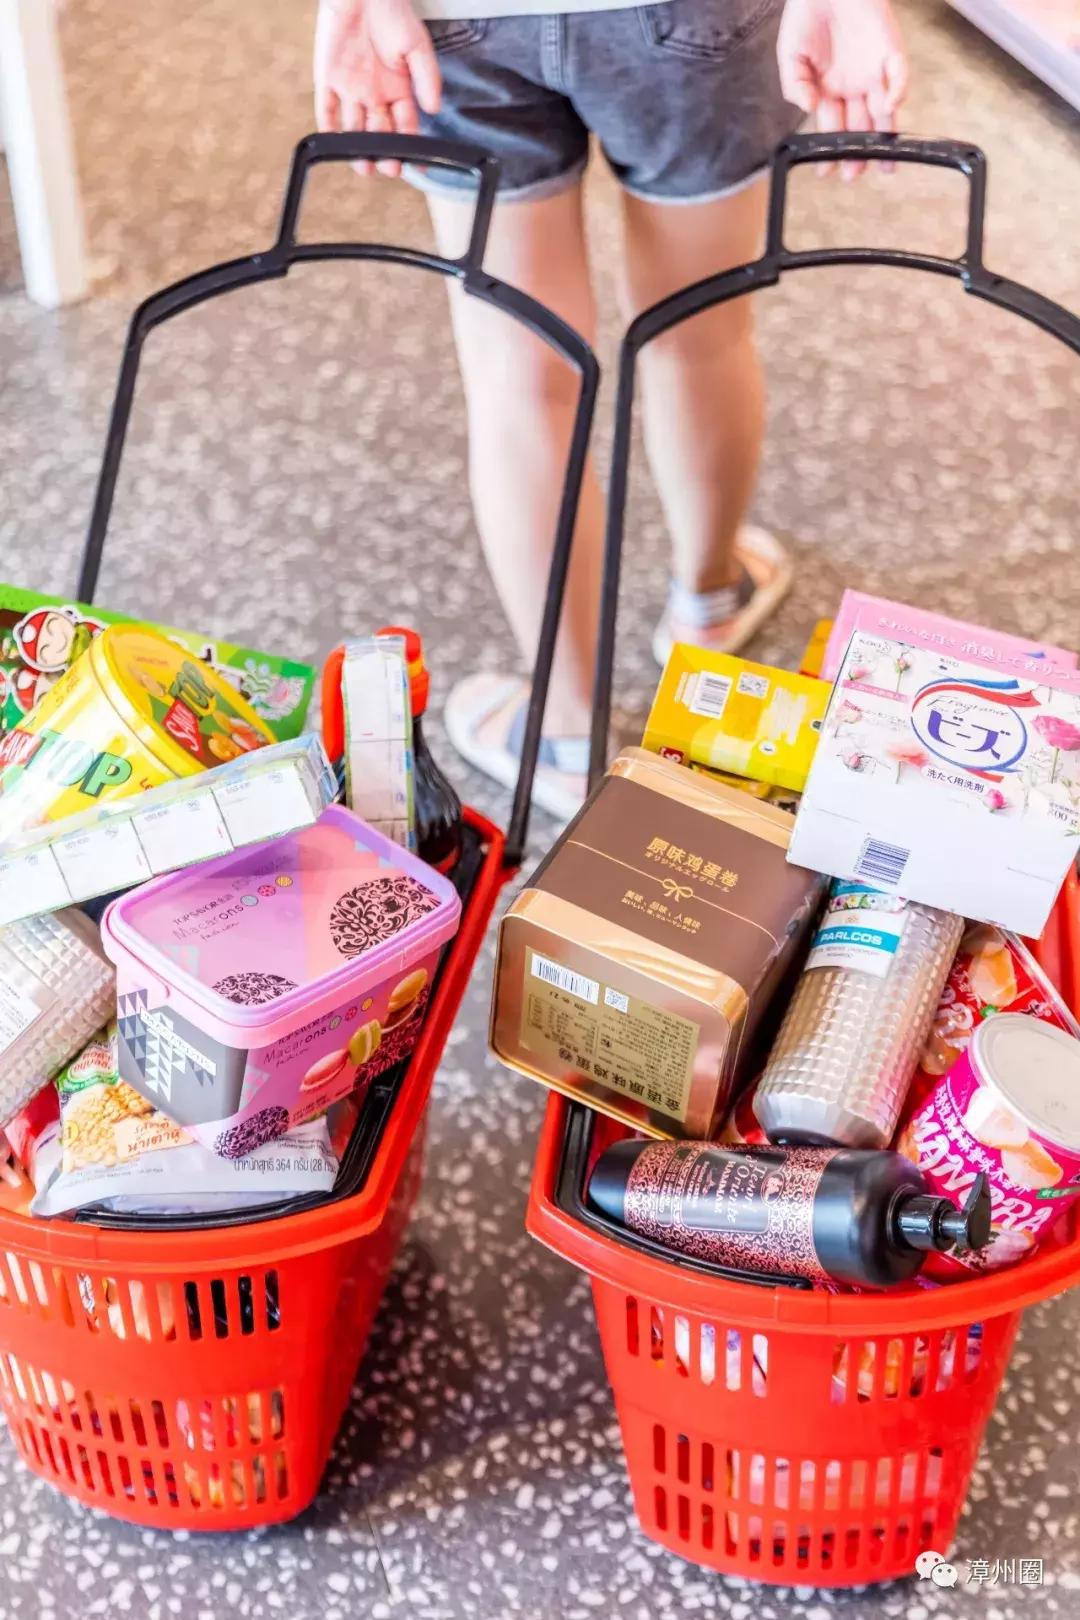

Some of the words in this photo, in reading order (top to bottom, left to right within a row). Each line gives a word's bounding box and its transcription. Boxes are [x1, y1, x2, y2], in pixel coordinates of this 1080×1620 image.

[24, 727, 133, 799] TOP
[646, 836, 739, 888] 原味鸡蛋卷
[820, 930, 882, 946] PARLCOS
[275, 1159, 291, 1171] 364
[714, 1160, 736, 1213] HAMMAM
[743, 1165, 767, 1212] Tesori
